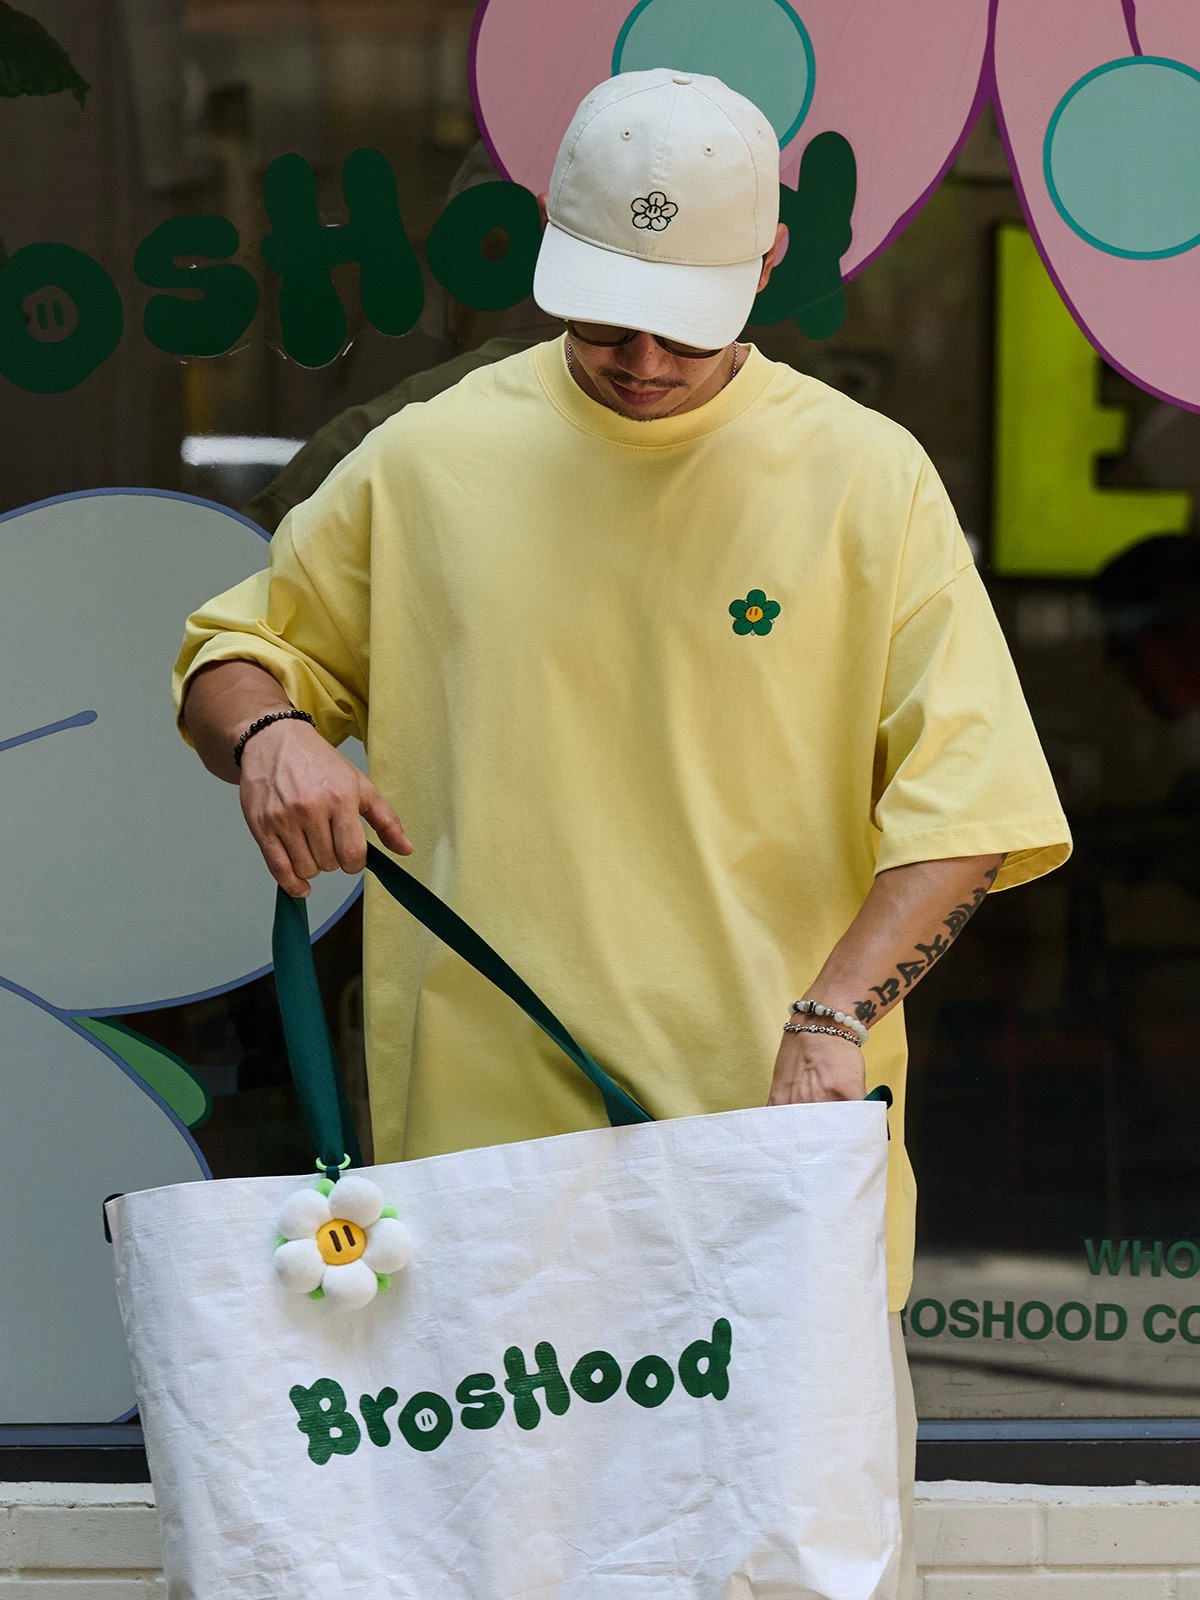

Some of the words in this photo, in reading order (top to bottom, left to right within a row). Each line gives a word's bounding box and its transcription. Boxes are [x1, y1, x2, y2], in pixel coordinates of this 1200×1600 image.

[0, 130, 856, 393] osHod
[1084, 1238, 1200, 1279] WHO
[900, 1298, 1127, 1341] OSHOOD
[289, 1317, 732, 1465] BrosHood
